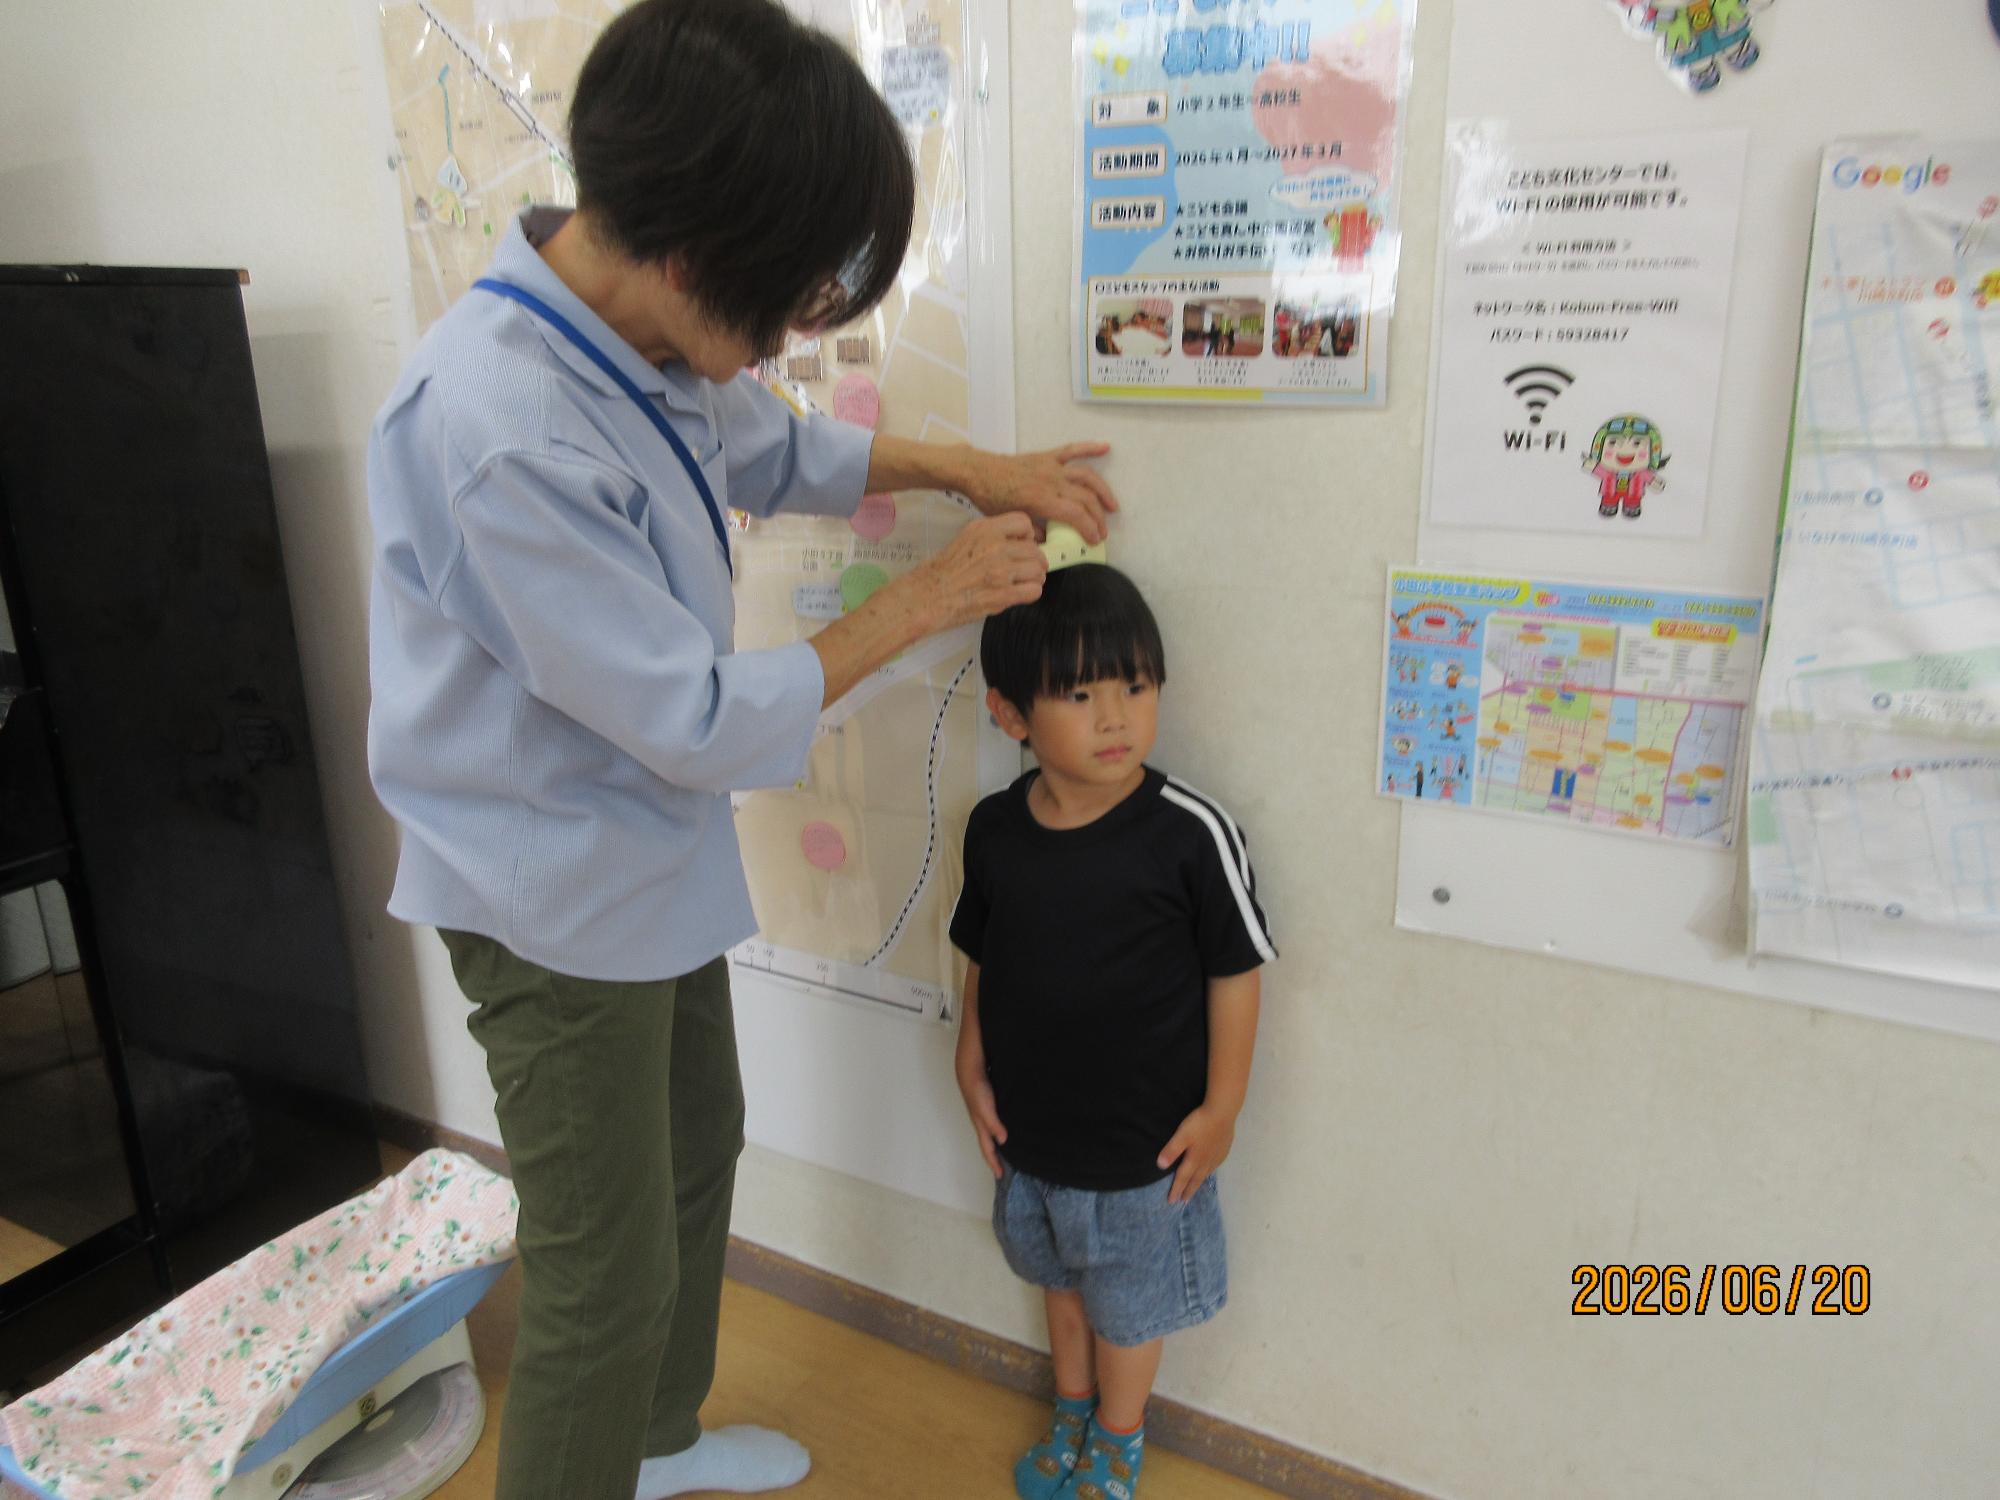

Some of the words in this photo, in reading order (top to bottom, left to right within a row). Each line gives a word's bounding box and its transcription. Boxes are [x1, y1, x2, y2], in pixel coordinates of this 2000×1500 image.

[1099, 151, 1159, 171] 活動期間
[1833, 154, 1952, 195] Google
[1098, 202, 1158, 222] 活動内容
[1504, 429, 1566, 452] Wi-Fi
